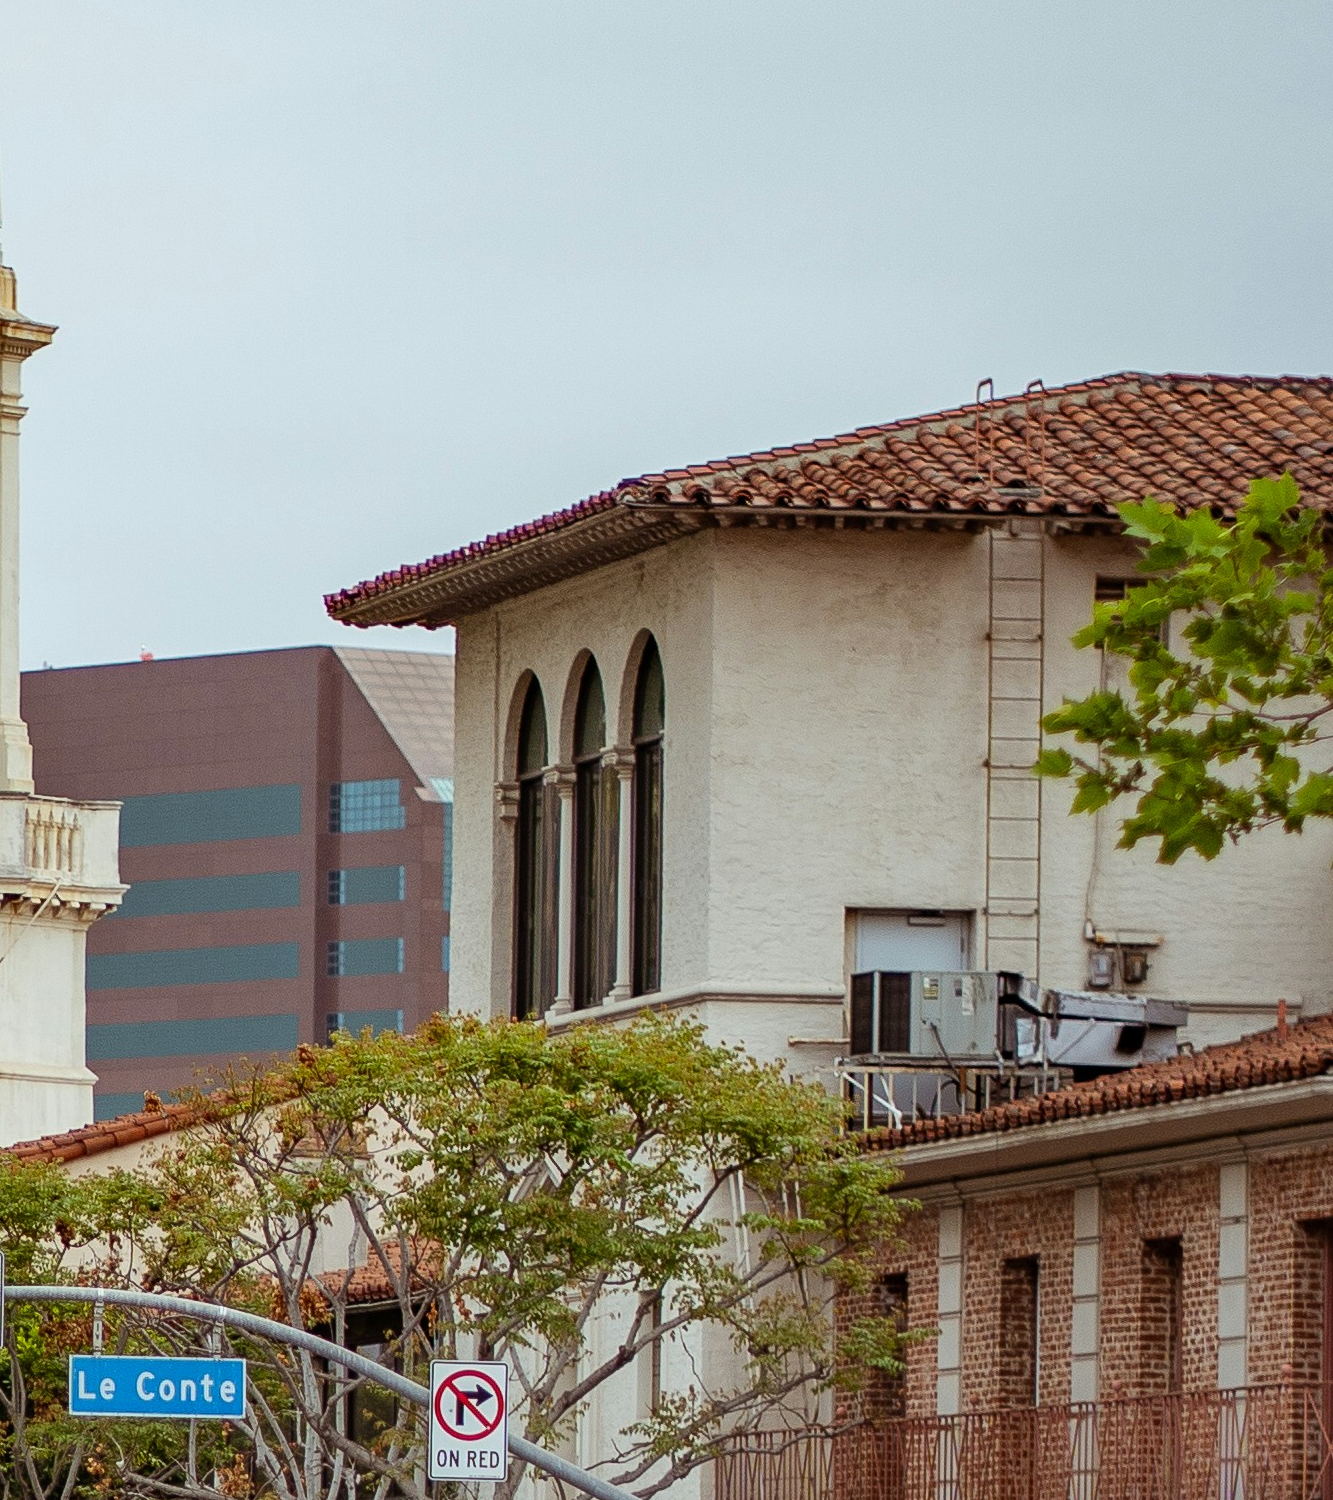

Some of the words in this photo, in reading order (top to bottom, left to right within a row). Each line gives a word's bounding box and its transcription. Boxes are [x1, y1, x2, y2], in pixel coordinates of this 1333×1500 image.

[78, 1370, 116, 1400] Le
[136, 1371, 236, 1403] Conte
[437, 1449, 459, 1468] ON
[467, 1450, 500, 1469] RED
